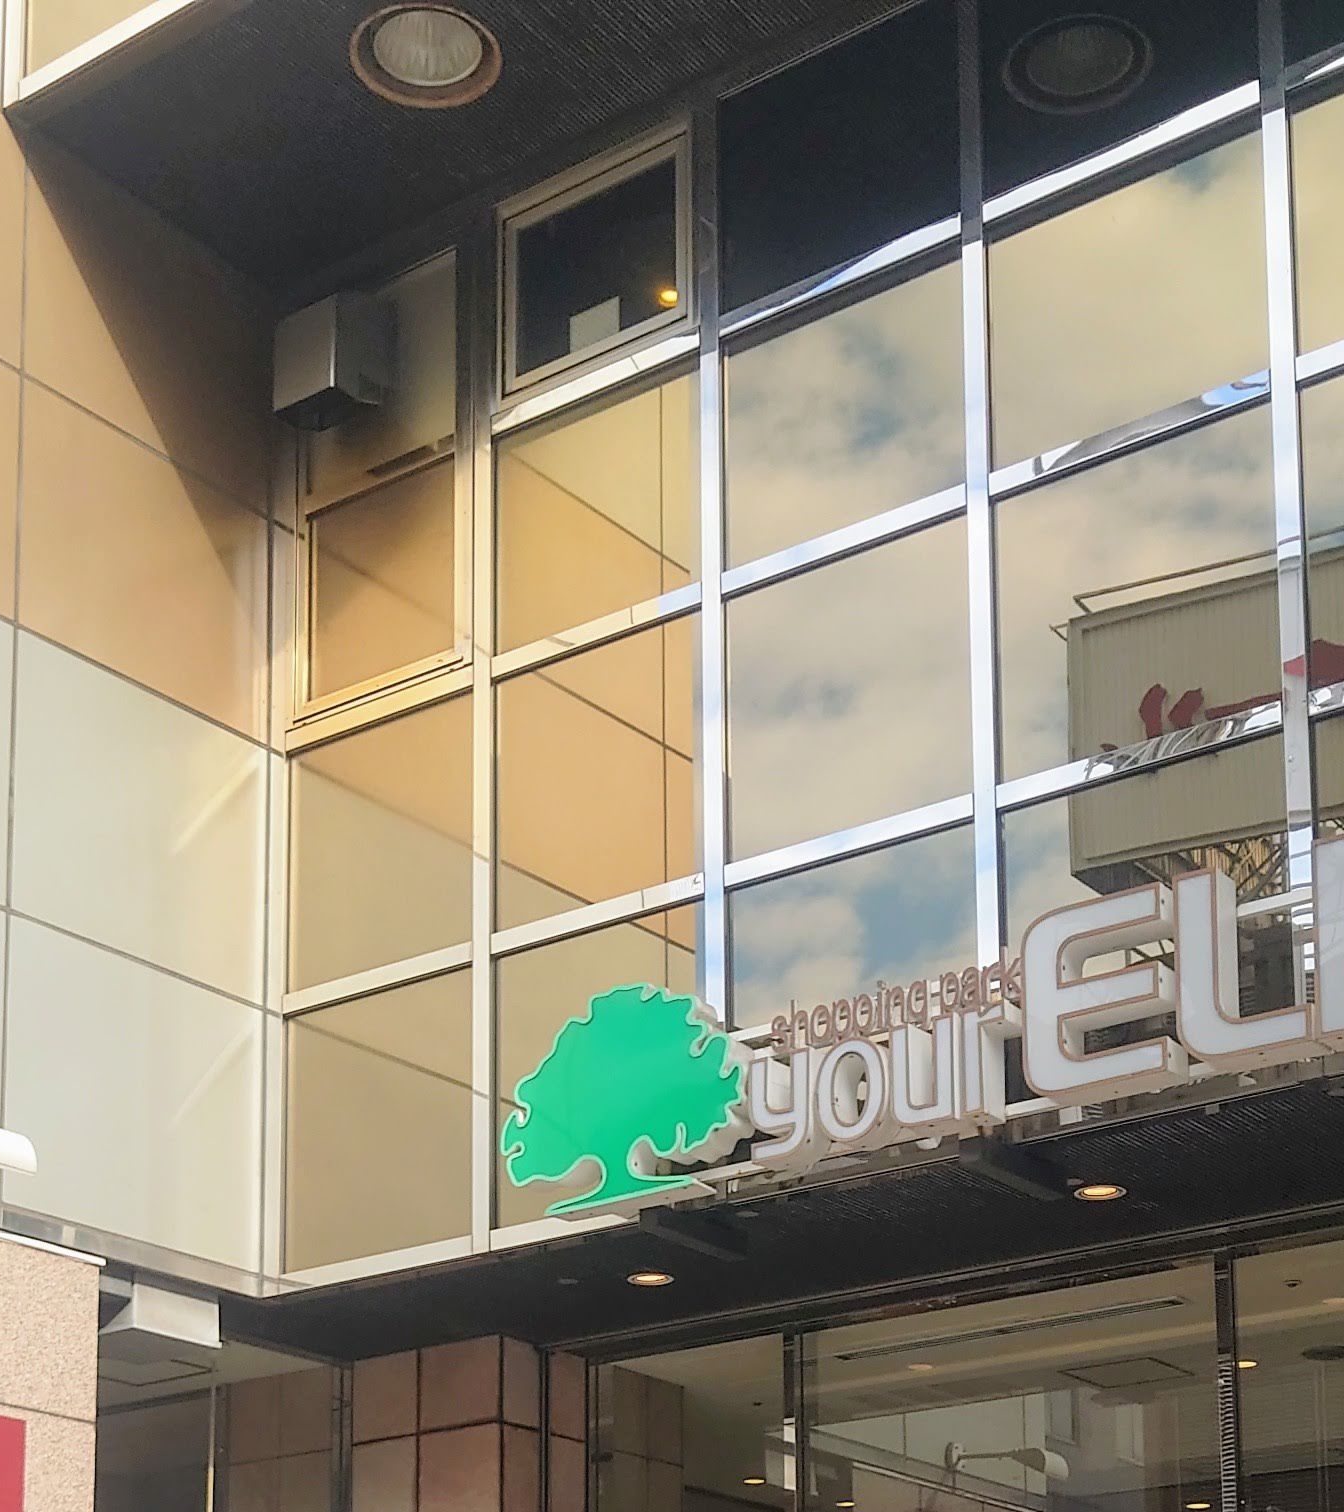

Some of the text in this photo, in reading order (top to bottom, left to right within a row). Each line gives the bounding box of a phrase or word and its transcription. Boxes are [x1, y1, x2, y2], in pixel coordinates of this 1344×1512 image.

[771, 958, 1023, 1050] shopping park
[751, 1003, 1006, 1167] your
